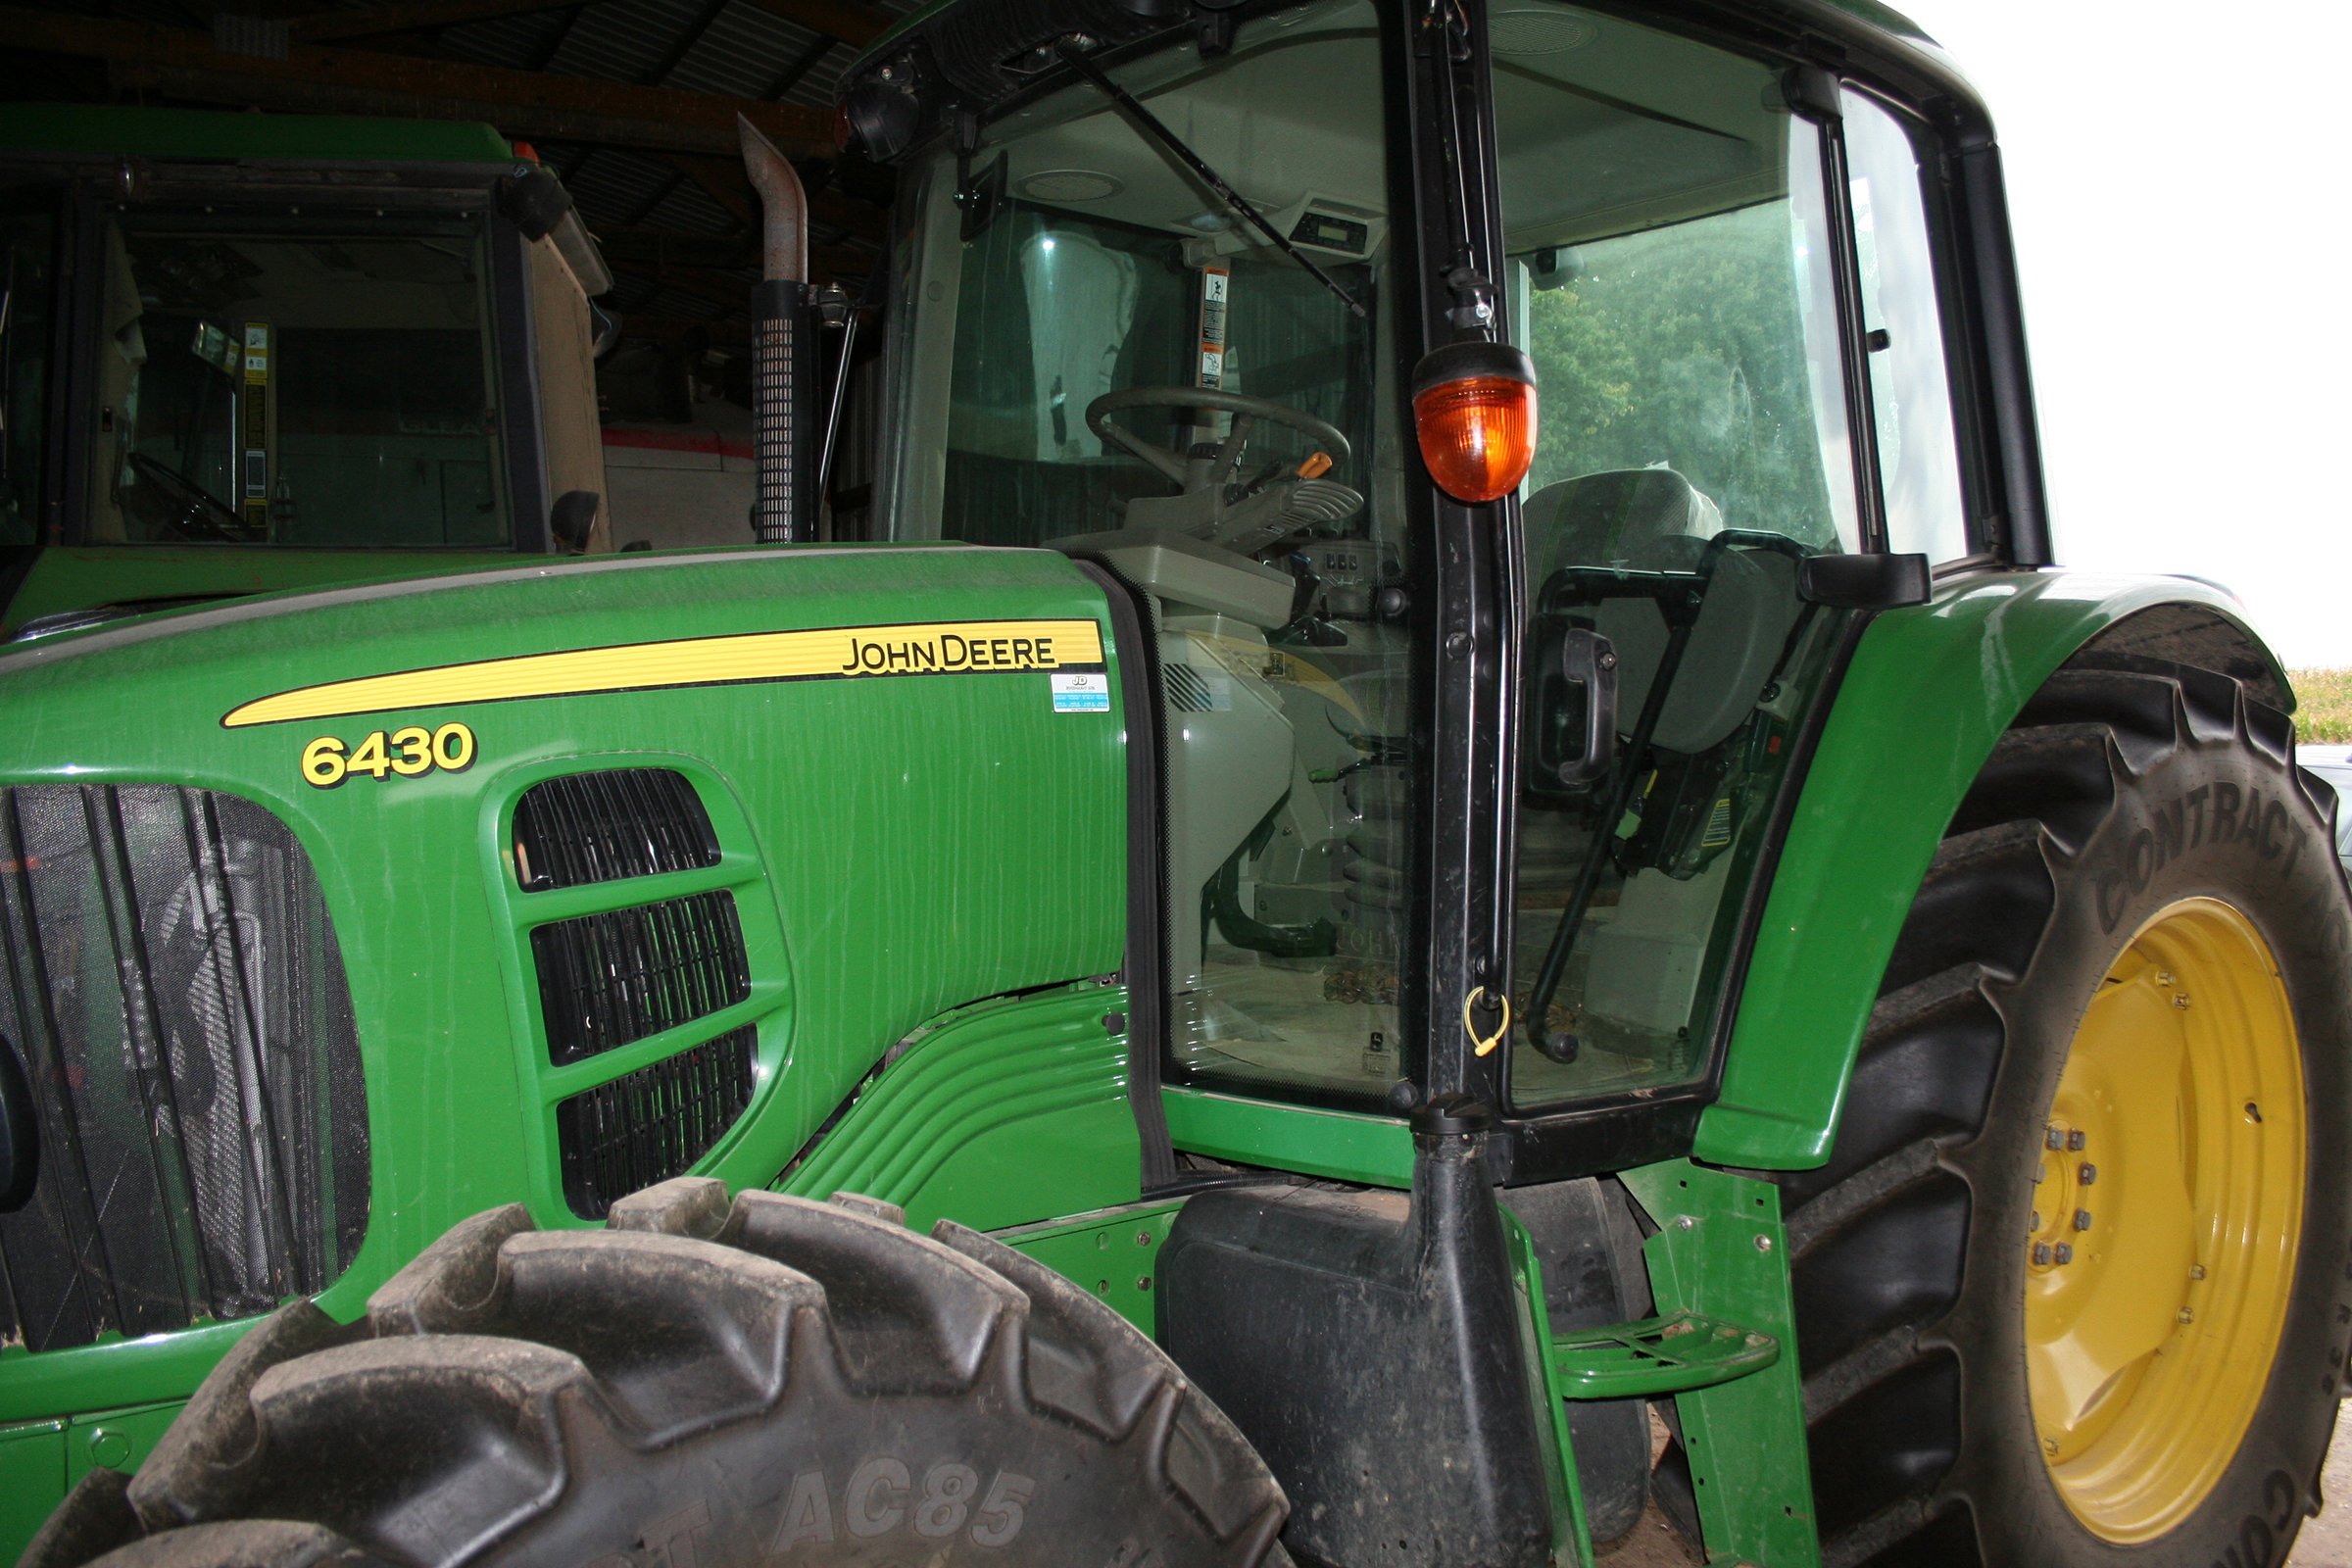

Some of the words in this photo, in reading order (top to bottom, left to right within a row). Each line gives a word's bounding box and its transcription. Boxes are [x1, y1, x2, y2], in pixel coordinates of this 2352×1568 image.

[843, 638, 936, 670] JOHN
[941, 634, 1054, 666] DEERE
[1072, 675, 1088, 686] JD
[301, 721, 476, 788] 6430
[2095, 781, 2306, 935] CONTRACT
[769, 1456, 1036, 1556] AC85
